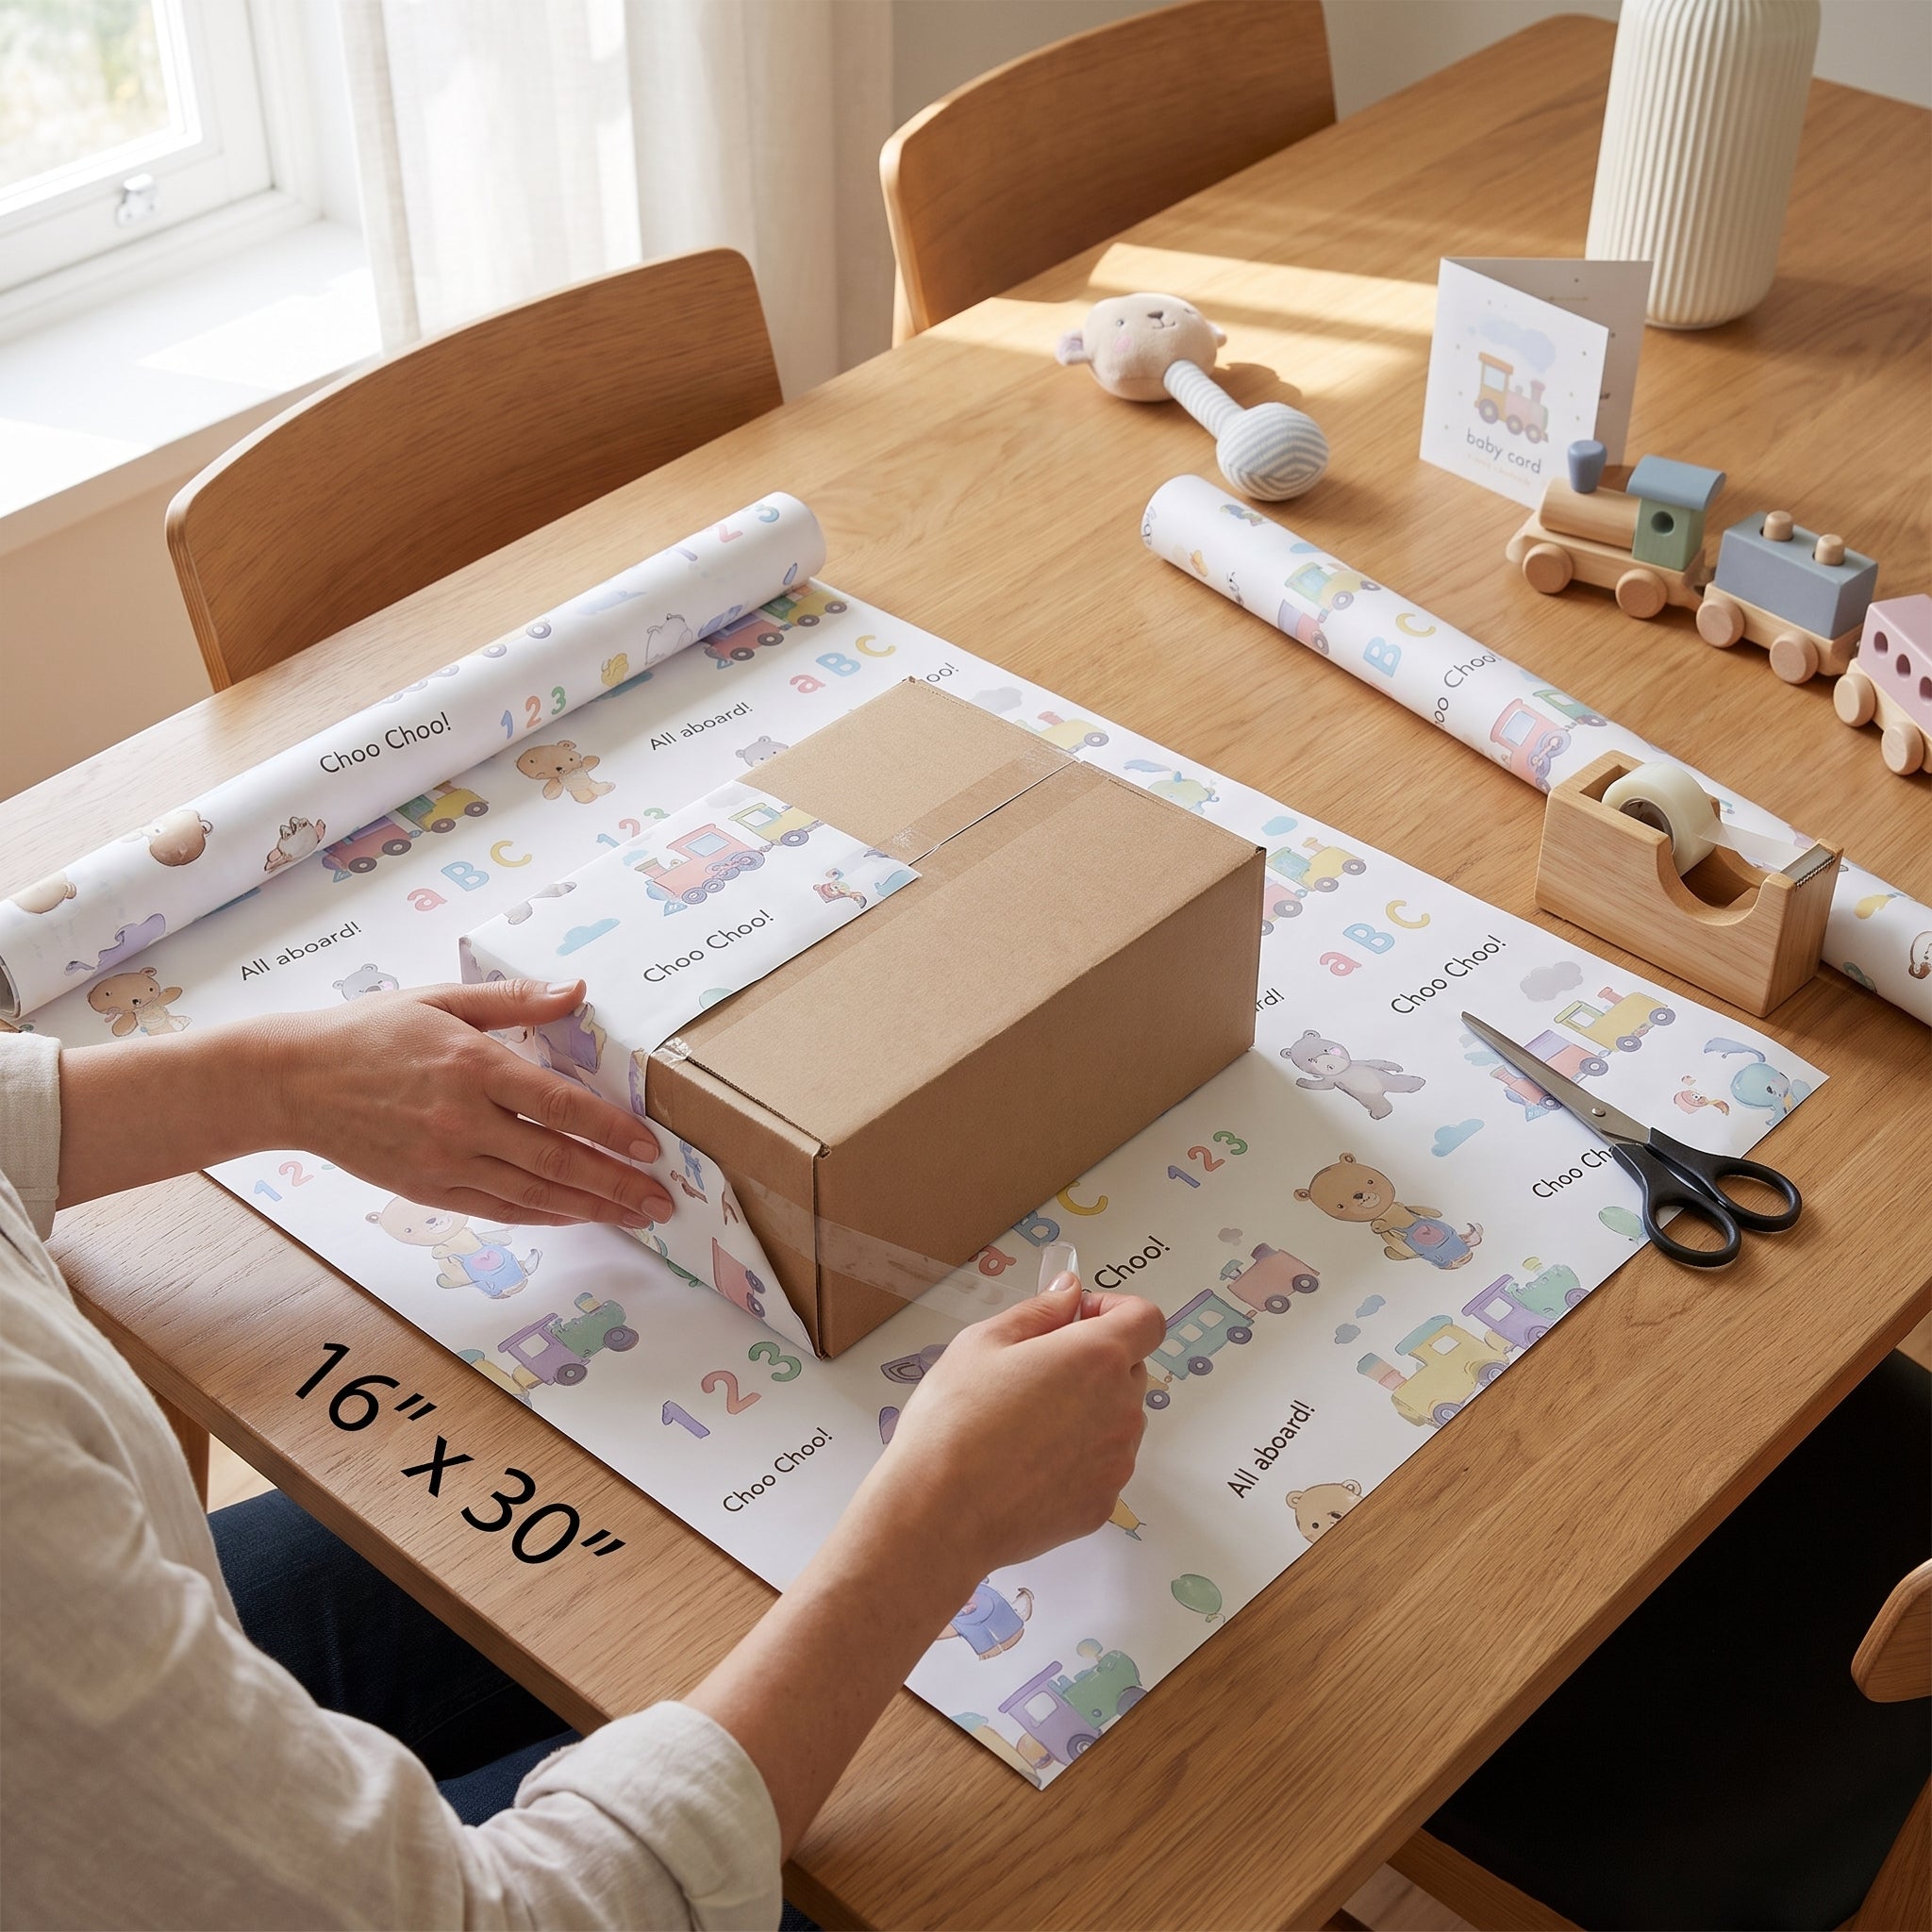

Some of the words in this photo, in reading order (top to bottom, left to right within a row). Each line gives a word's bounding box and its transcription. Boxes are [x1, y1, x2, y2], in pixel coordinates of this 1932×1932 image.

[1466, 426, 1503, 461] baby
[320, 743, 381, 774] Choo
[384, 711, 452, 750] Choo!
[650, 730, 677, 751] All
[680, 701, 753, 738] aboard!
[241, 958, 272, 981] All
[275, 921, 362, 965] aboard!
[643, 950, 705, 982] Choo
[706, 908, 774, 949] Choo!
[1391, 978, 1448, 1014] Choo
[1443, 934, 1507, 977] Choo!
[1532, 1168, 1584, 1198] Choo
[1093, 1234, 1171, 1290] Choo!
[723, 1474, 776, 1513] Choo
[774, 1426, 834, 1474] Choo!
[1226, 1468, 1260, 1499] All
[1253, 1399, 1317, 1471] aboard!
